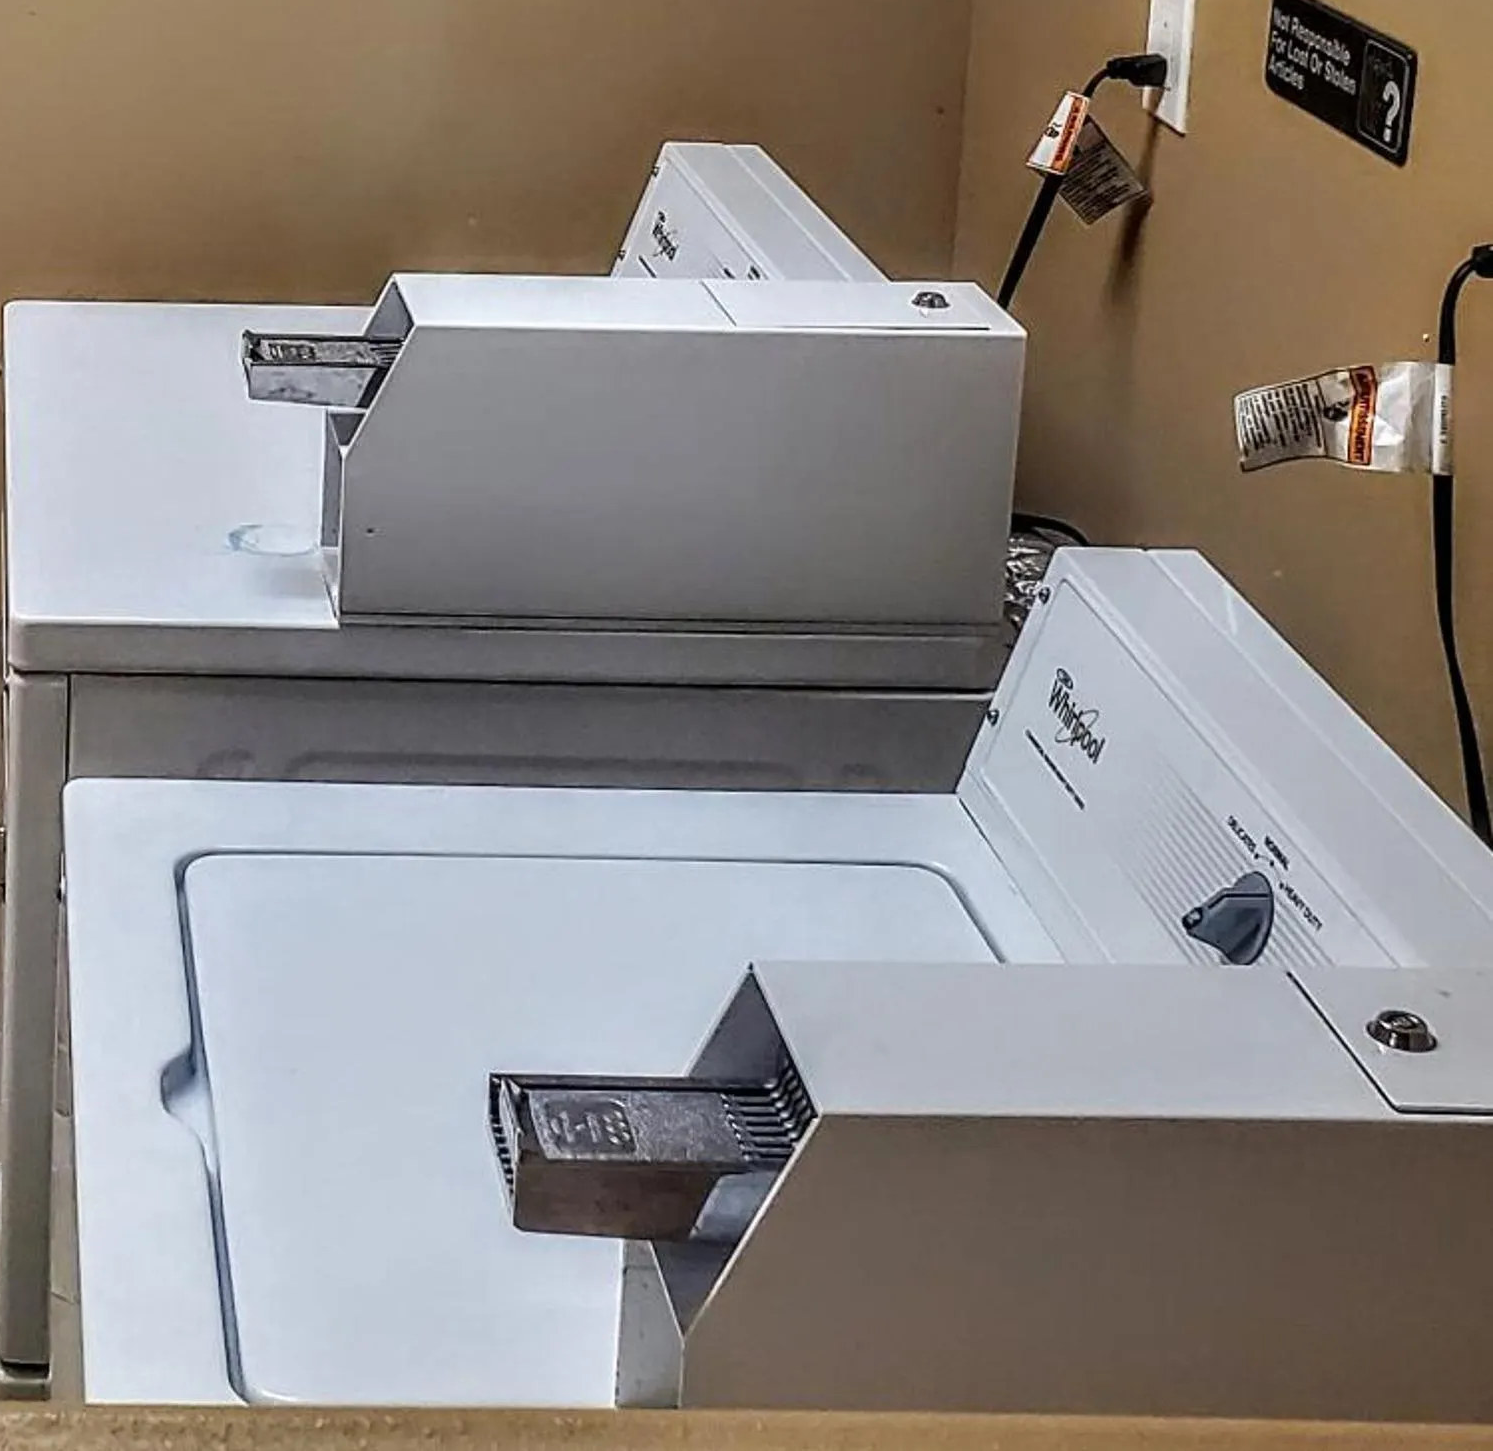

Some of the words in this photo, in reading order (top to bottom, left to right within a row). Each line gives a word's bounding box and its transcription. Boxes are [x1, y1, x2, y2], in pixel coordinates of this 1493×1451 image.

[1272, 30, 1287, 53] For
[1287, 39, 1308, 68] Lost
[1309, 52, 1322, 76] Or
[1324, 61, 1356, 96] Stolen
[1273, 7, 1290, 32] Not
[1291, 16, 1351, 67] Responsible
[1268, 54, 1305, 91] Articles
[1048, 678, 1106, 764] Whirlpool
